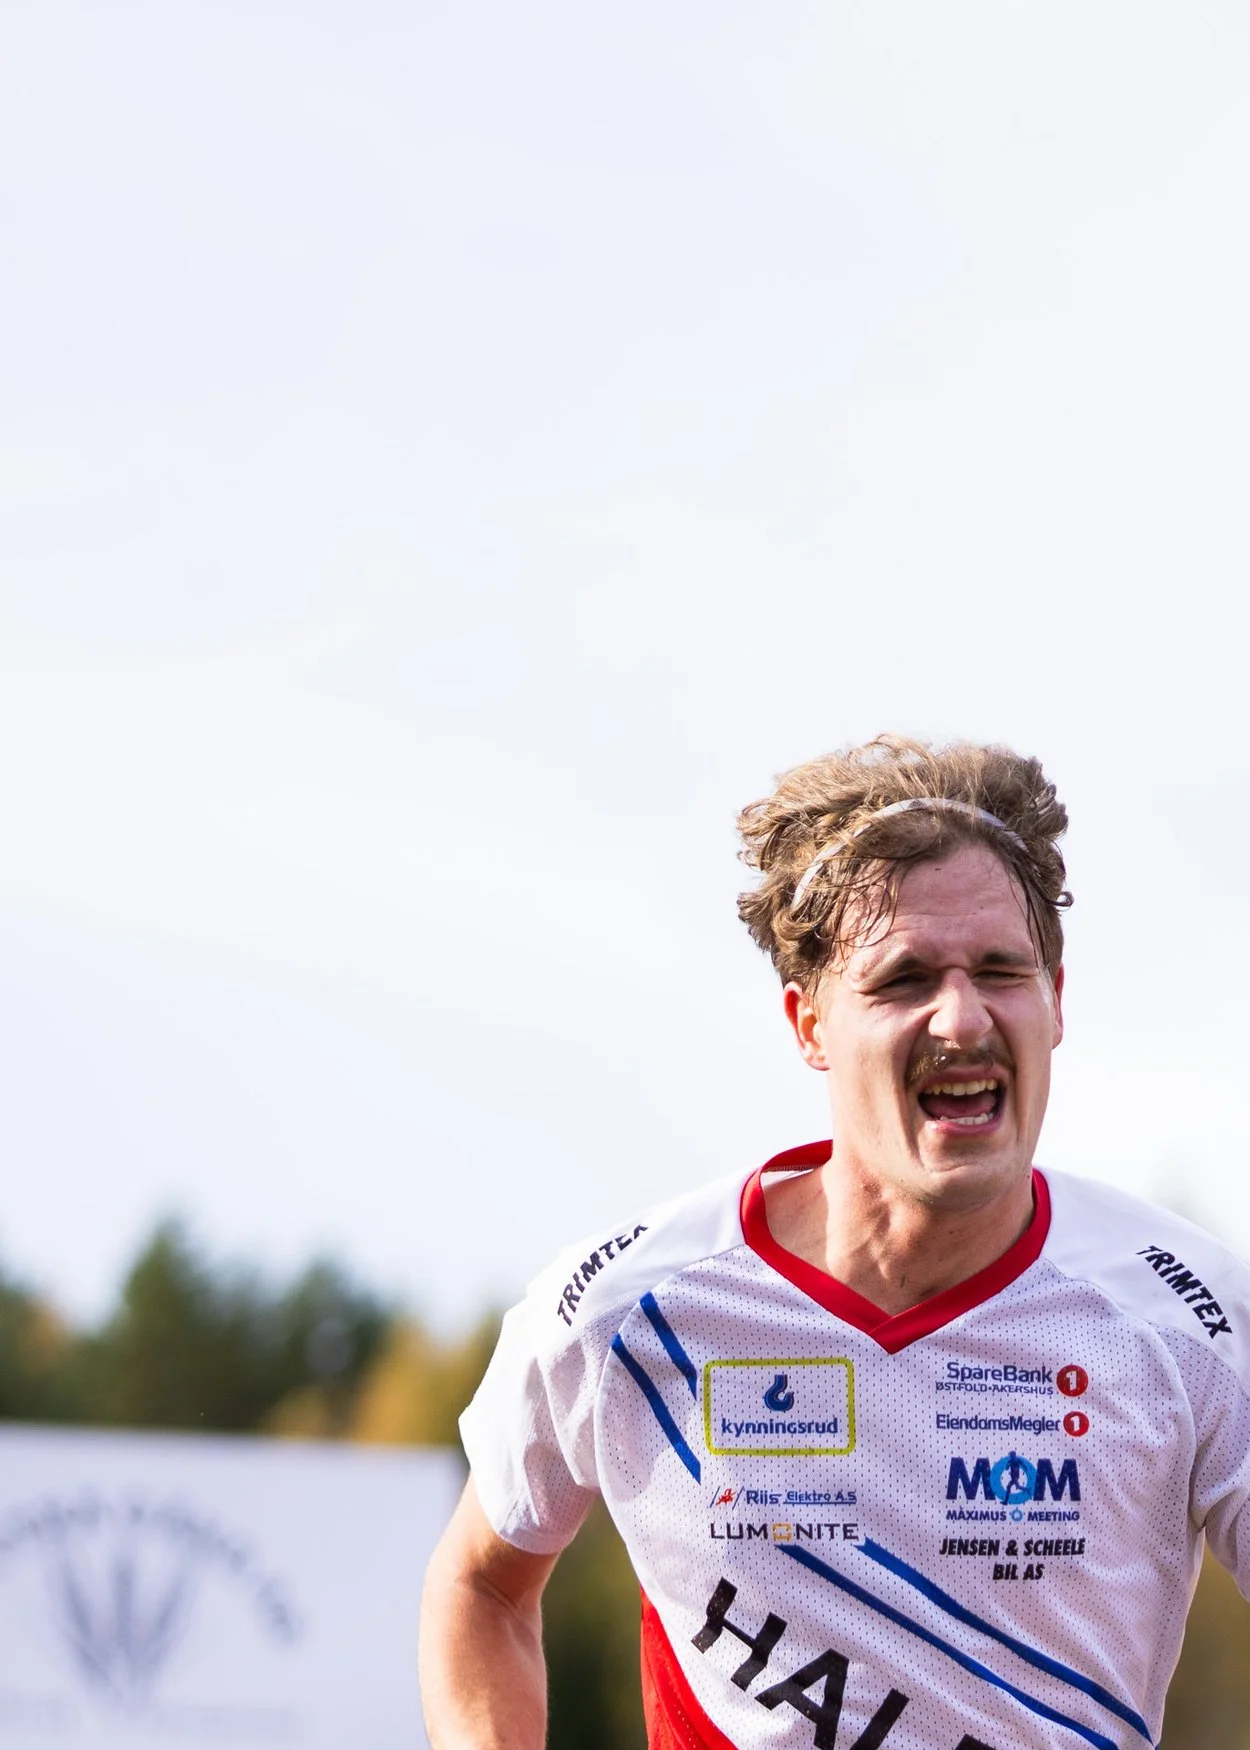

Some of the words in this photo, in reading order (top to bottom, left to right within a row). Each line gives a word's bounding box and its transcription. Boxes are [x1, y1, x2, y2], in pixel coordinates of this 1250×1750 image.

[1135, 1245, 1233, 1339] TRIMTEX
[946, 1362, 1053, 1383] SpareBank
[721, 1417, 838, 1437] kynningsrud
[936, 1413, 1061, 1435] EiendomsMegler
[946, 1450, 1081, 1505] MOM
[746, 1490, 782, 1504] Riis
[787, 1490, 831, 1502] Elektro
[946, 1509, 1007, 1521] MAXIMUS
[1027, 1510, 1080, 1522] MEETING
[710, 1522, 859, 1541] LUMONITE
[939, 1538, 1000, 1556] JENSEN
[1005, 1540, 1019, 1556] &
[1023, 1537, 1086, 1556] SCHEELE
[992, 1563, 1019, 1580] BIL
[1023, 1564, 1045, 1580] AS
